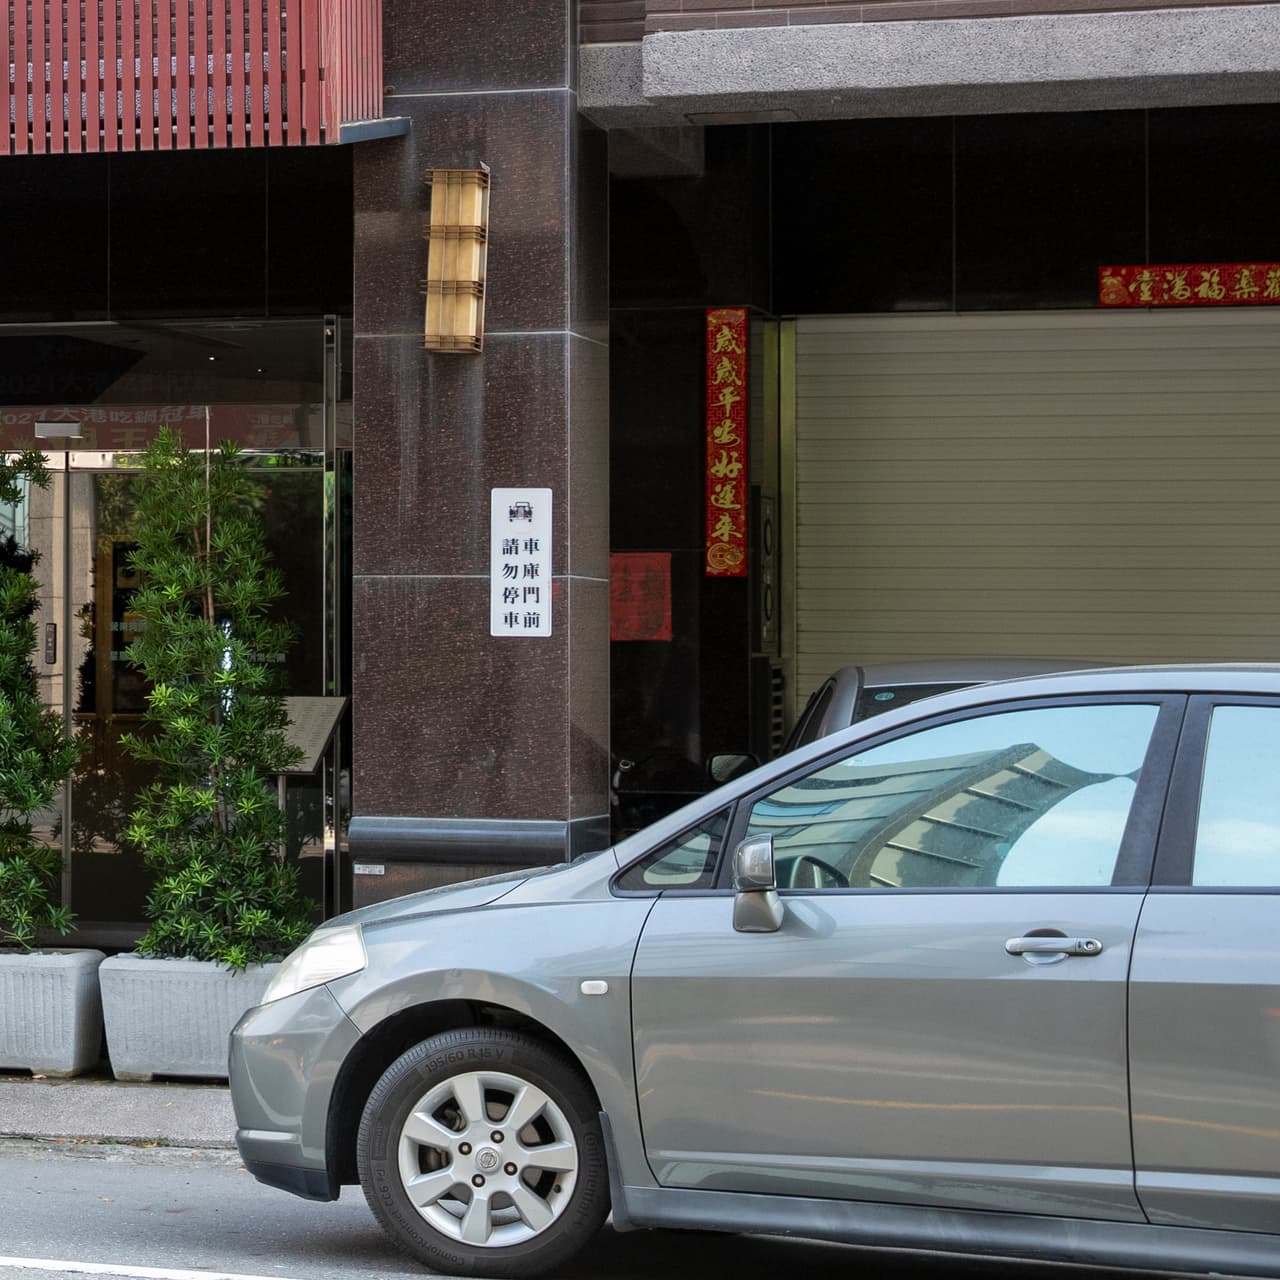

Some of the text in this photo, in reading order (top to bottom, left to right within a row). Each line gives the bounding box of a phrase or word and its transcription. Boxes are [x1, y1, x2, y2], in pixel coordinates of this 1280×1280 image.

[502, 537, 521, 629] 請勿停車
[522, 537, 541, 629] 車庫門前
[425, 1050, 465, 1073] 195/60
